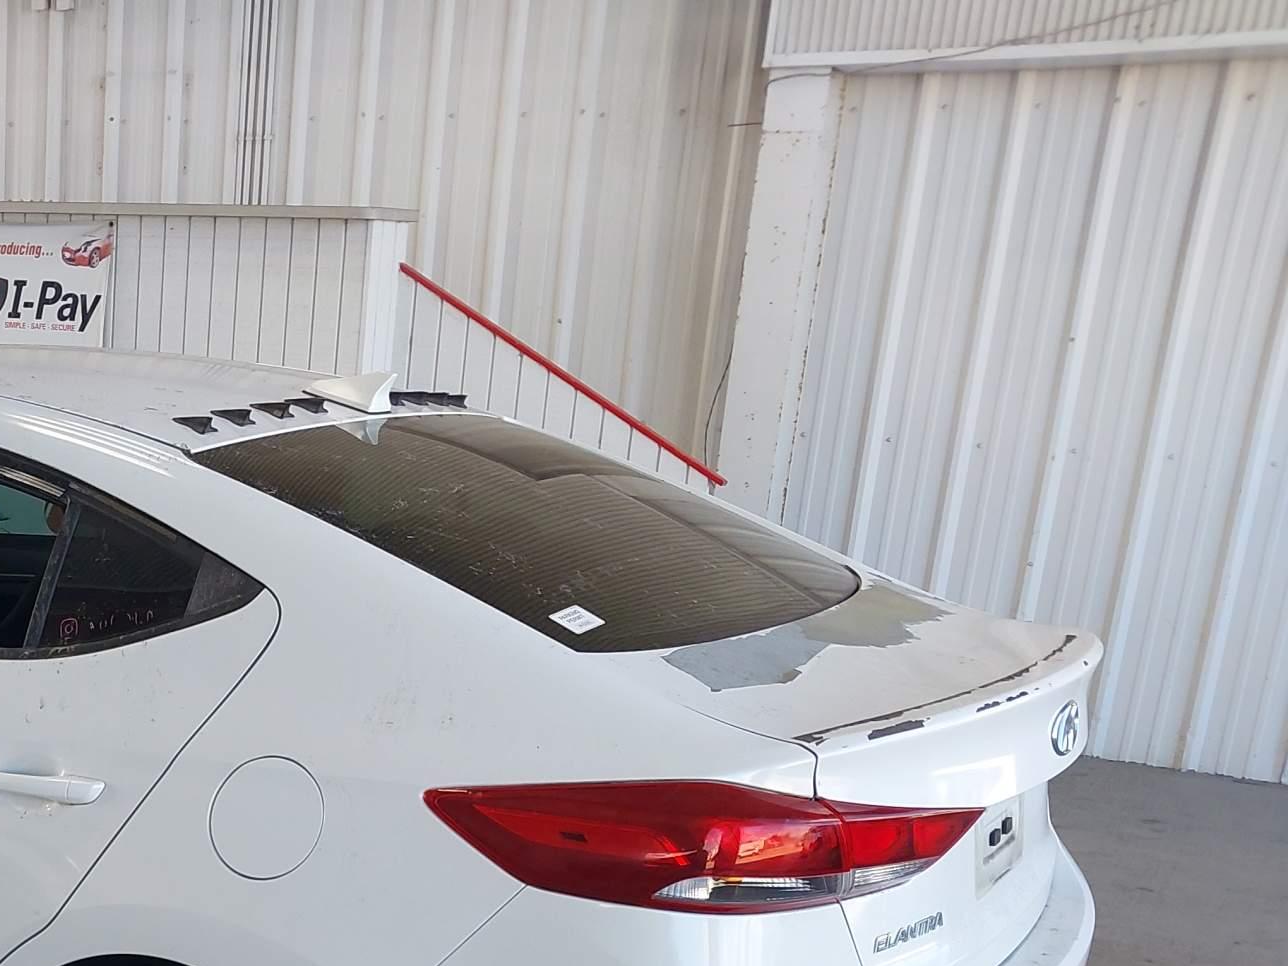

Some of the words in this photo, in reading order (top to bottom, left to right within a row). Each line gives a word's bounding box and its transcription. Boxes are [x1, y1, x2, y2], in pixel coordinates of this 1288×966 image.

[4, 321, 26, 329] SIMPLE
[30, 322, 46, 330] SAFE
[51, 323, 76, 331] SECURE
[7, 280, 102, 332] I-Pay
[873, 912, 943, 953] ELANTRA
